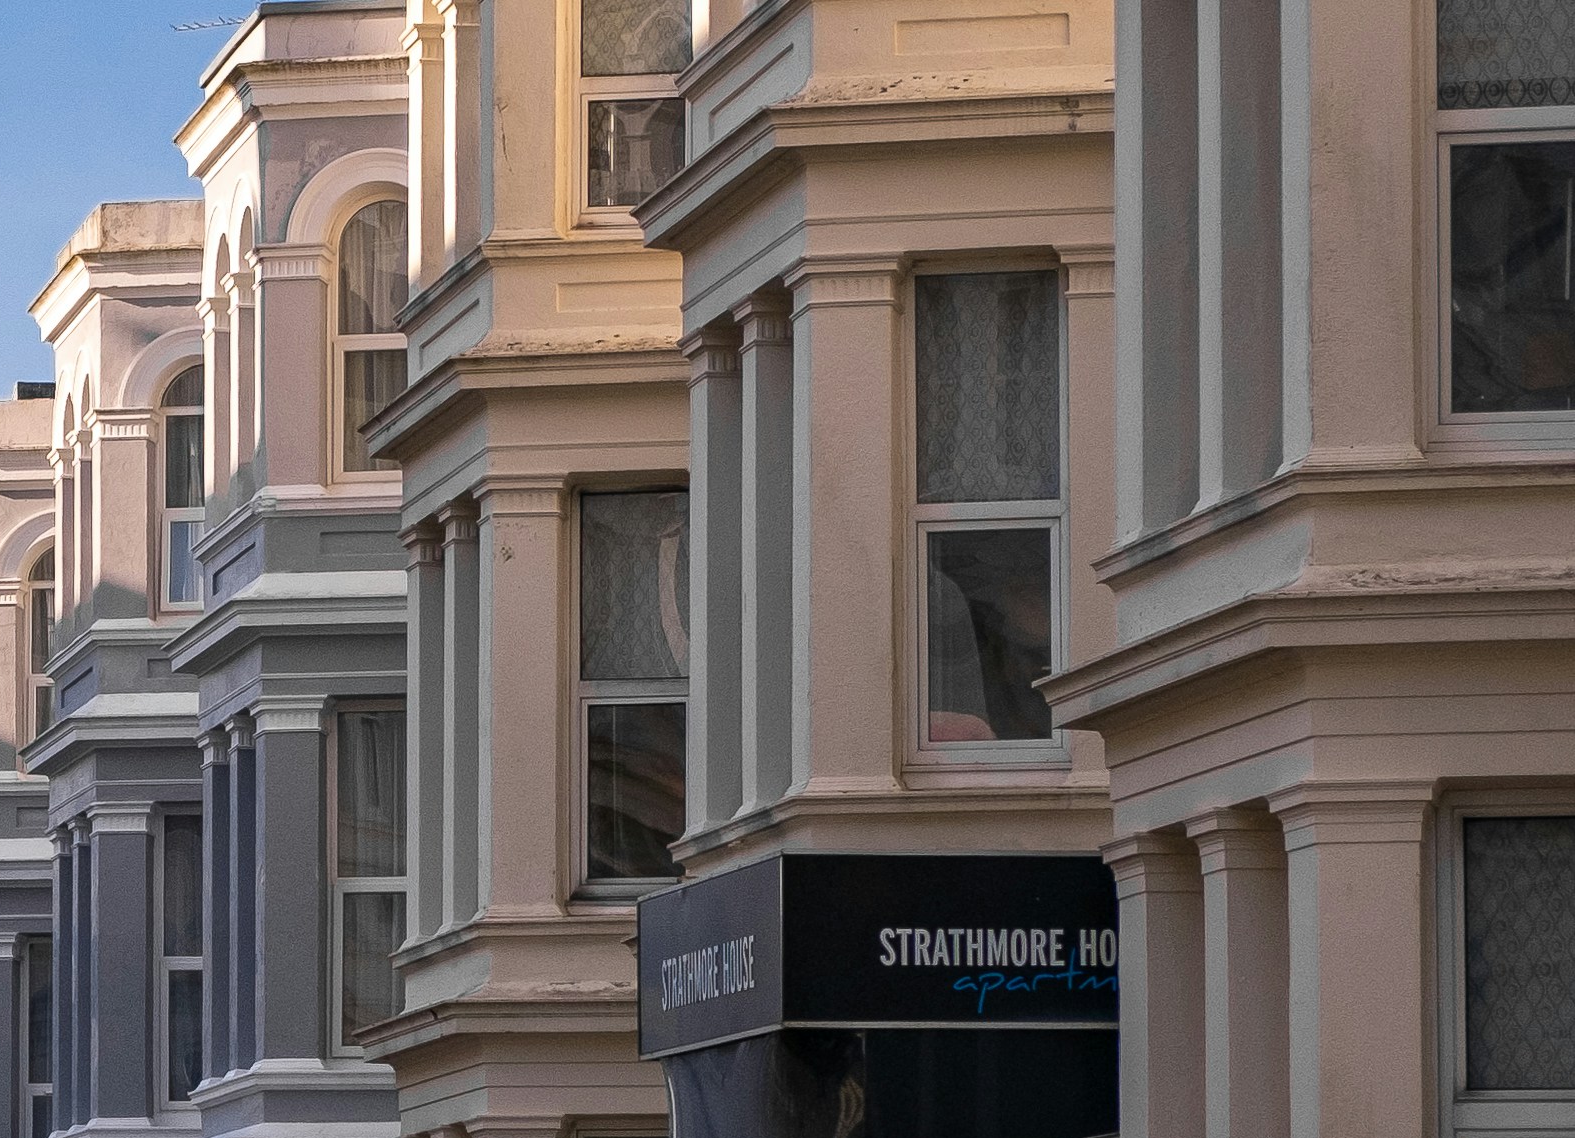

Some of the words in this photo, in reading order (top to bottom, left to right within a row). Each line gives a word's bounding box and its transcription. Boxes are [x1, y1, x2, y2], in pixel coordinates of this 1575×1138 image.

[661, 944, 719, 1013] STRATHMORE
[722, 934, 755, 996] HOUSE
[879, 927, 1066, 967] STRATHMORE
